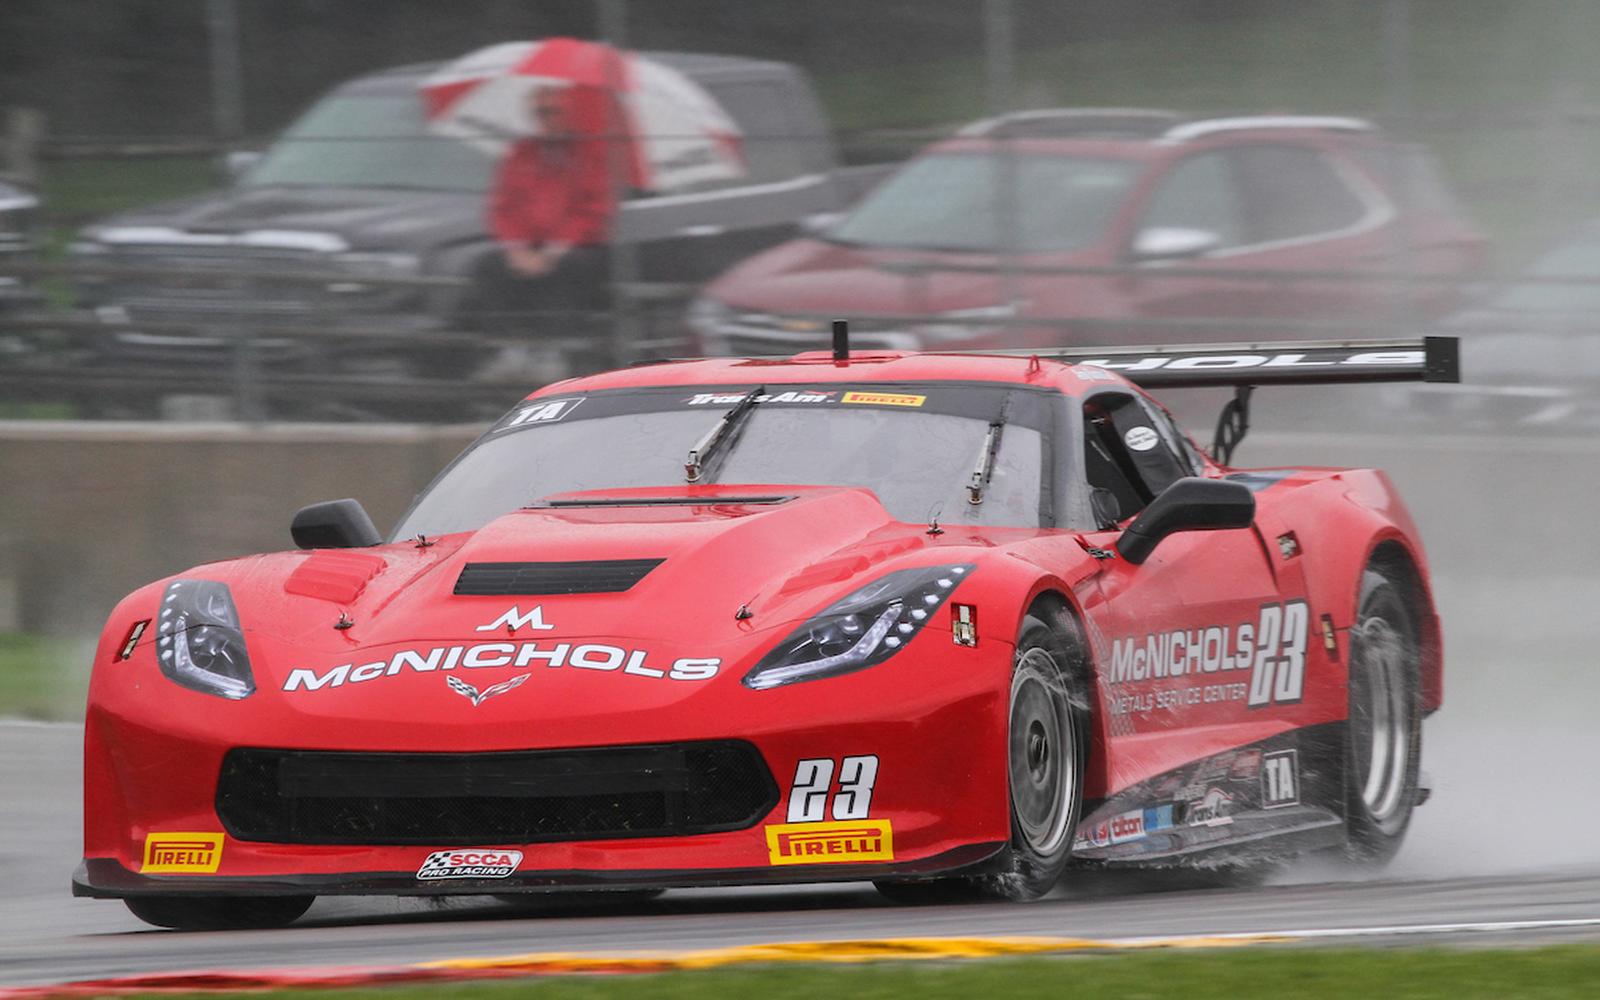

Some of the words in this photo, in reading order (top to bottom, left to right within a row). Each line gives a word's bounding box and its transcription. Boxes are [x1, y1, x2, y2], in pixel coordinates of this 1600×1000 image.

[509, 401, 567, 426] TA
[850, 394, 917, 404] PIRELLI
[282, 642, 722, 692] McNICHOLS
[1109, 624, 1254, 683] McNICHOLS
[1248, 599, 1309, 708] 23
[1110, 693, 1153, 714] METALS
[1156, 687, 1201, 708] SERVICE
[1203, 683, 1247, 703] CENTER
[786, 754, 880, 824] 23
[1265, 757, 1295, 801] TA
[148, 841, 216, 866] PIRELLI
[777, 828, 882, 857] PIRELLI
[422, 868, 450, 878] PRO
[452, 867, 510, 876] RACING
[450, 854, 513, 866] SCCA
